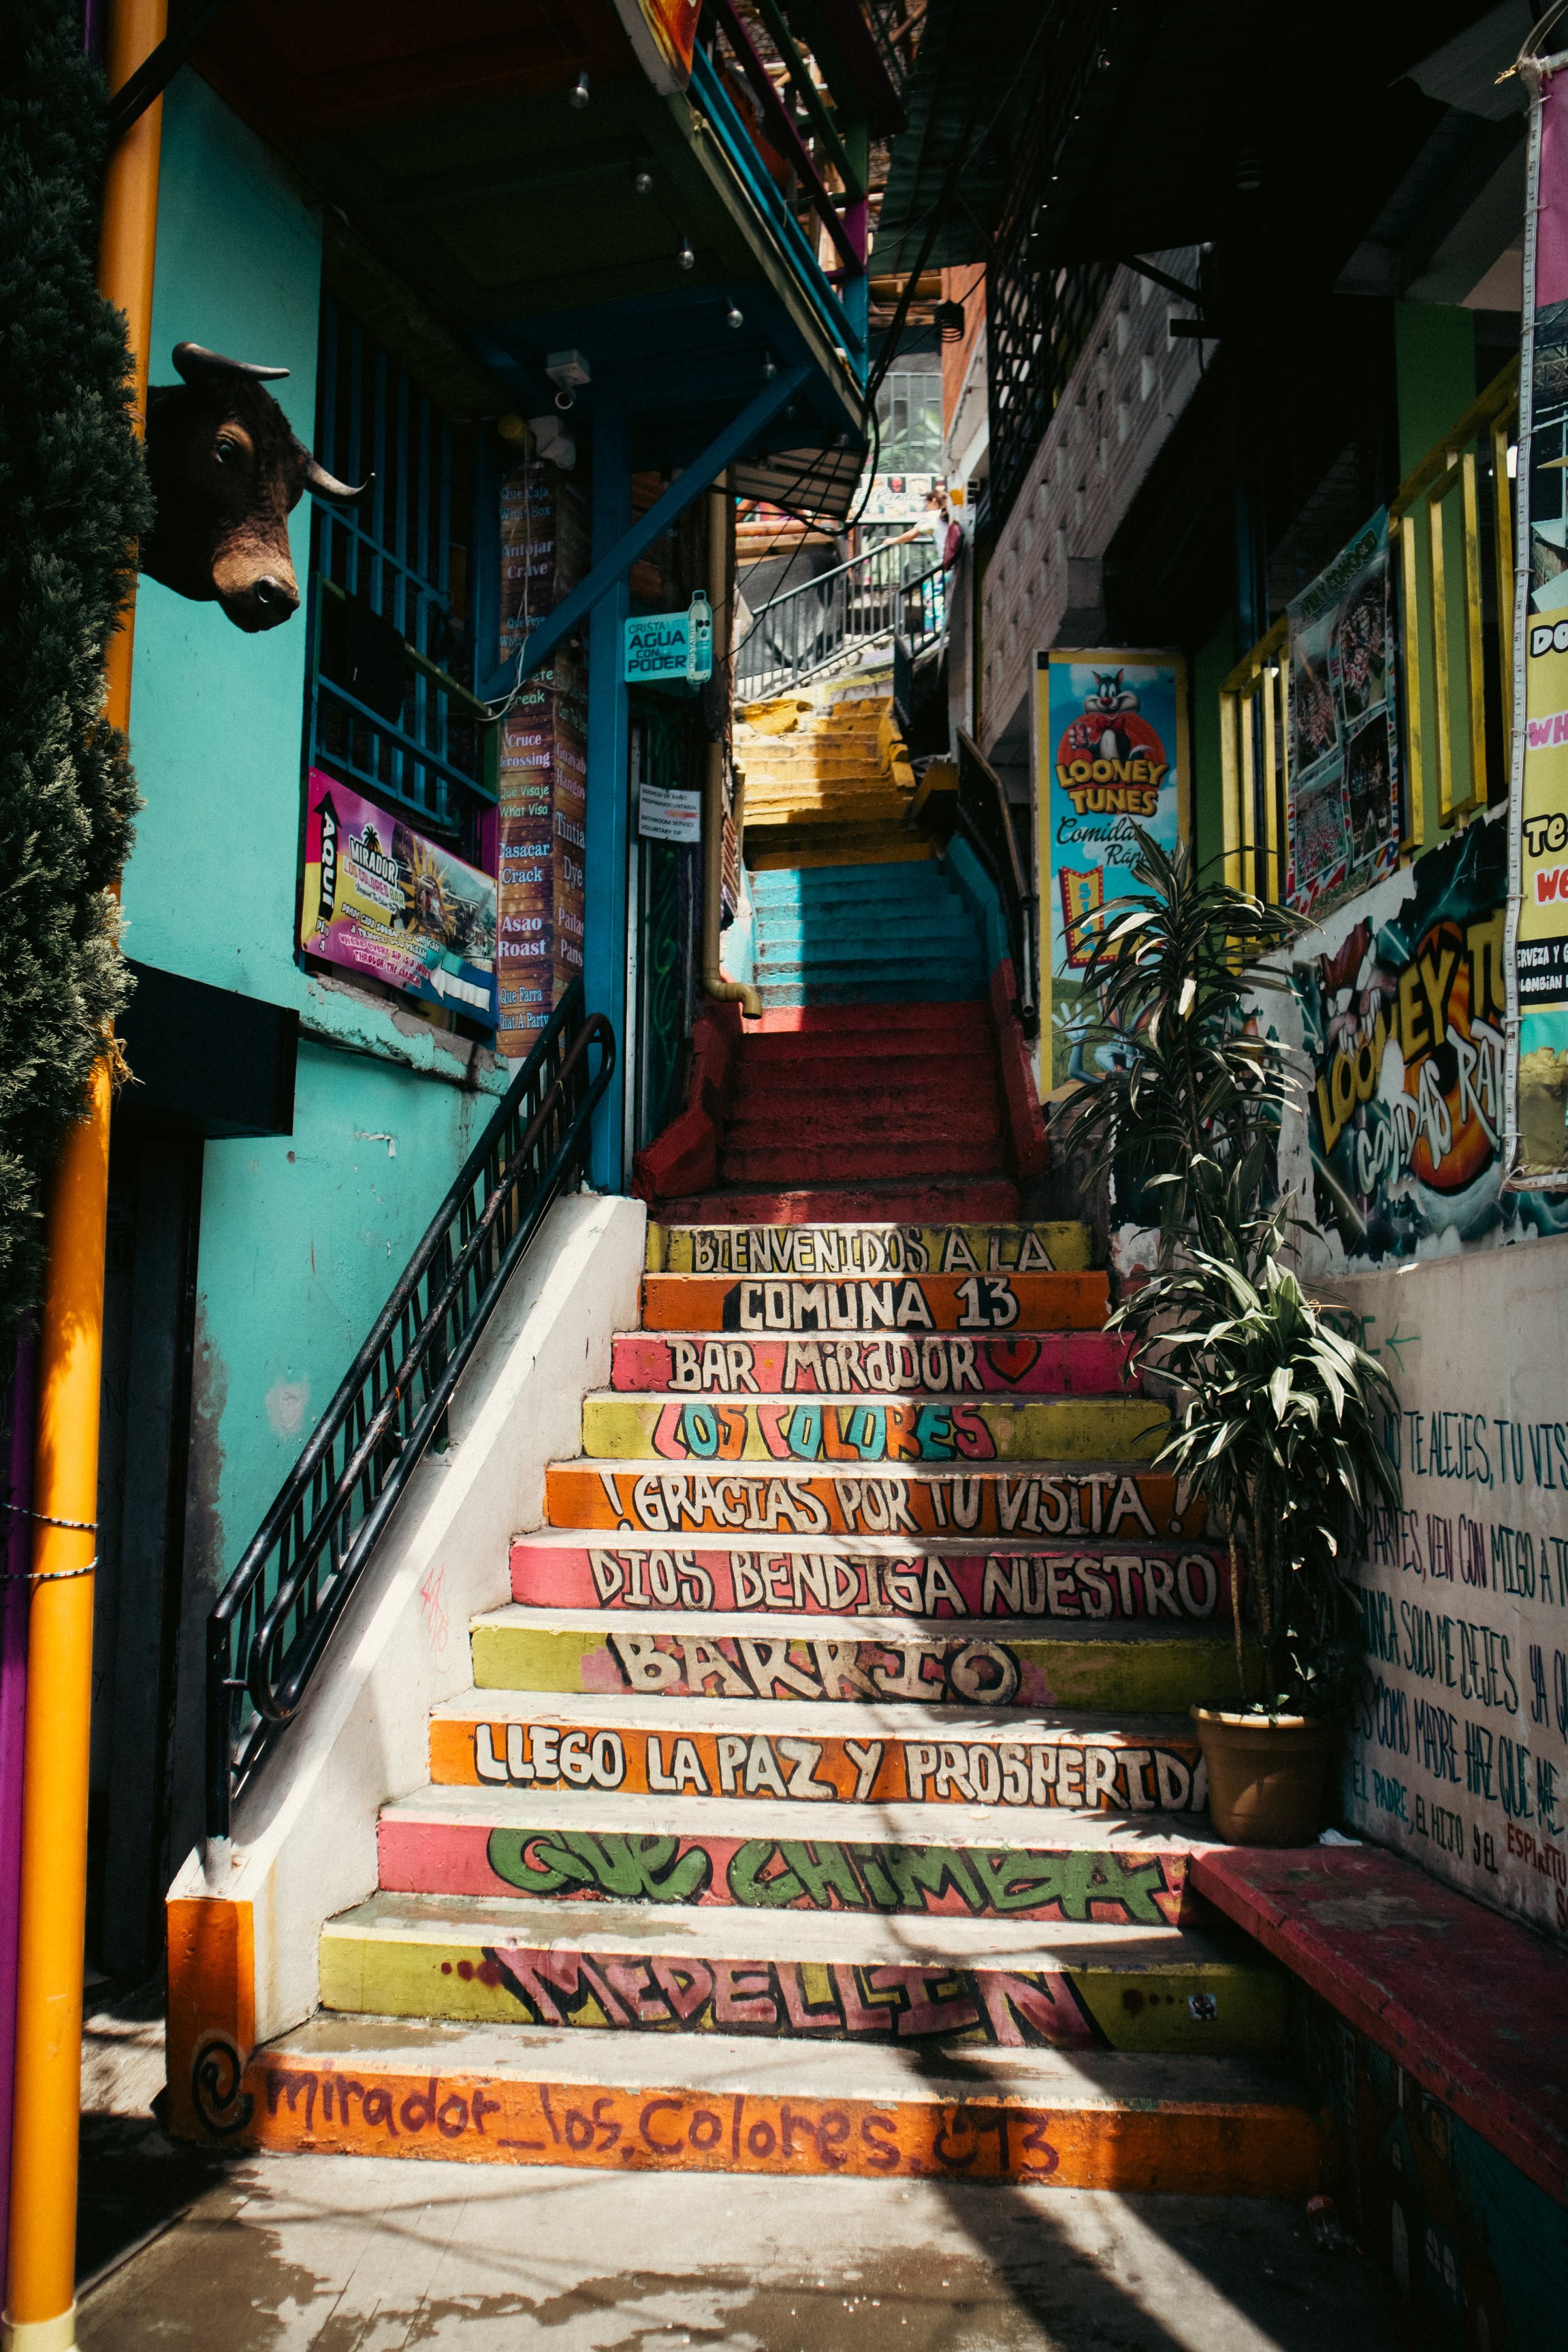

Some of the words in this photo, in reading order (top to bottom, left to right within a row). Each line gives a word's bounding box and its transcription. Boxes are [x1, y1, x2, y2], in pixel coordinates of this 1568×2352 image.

[502, 539, 554, 558] Antojar
[507, 563, 549, 579] Crave
[628, 630, 686, 650] AGUA
[628, 655, 687, 672] PODER
[636, 648, 659, 659] CON
[508, 734, 542, 747] Cruce
[501, 752, 550, 768] Crossing
[1056, 758, 1169, 789] LOONEY
[521, 785, 549, 798] Visaje
[1067, 788, 1159, 817] TUNES
[500, 805, 525, 817] What
[529, 803, 548, 815] Visa
[642, 815, 671, 825] BATHROOM
[641, 824, 671, 834] VOLUNTARY
[1056, 815, 1142, 844] Comida
[350, 837, 397, 887] MIRADOR
[502, 866, 543, 884] Crack
[358, 868, 389, 898] COLORES
[389, 887, 405, 907] BAR
[502, 916, 542, 932] Asao
[499, 939, 546, 957] Roast
[1517, 946, 1549, 968] ERVEZA
[1553, 945, 1560, 963] Y
[500, 988, 516, 1005] Que
[519, 986, 543, 1003] Farra
[518, 1014, 524, 1029] A
[526, 1012, 549, 1030] Party
[693, 1227, 928, 1273] BIENVENIDOS
[943, 1231, 980, 1273] A
[987, 1232, 1056, 1273] LA
[734, 1278, 936, 1331] COMUNA
[956, 1276, 1019, 1329] 13
[666, 1339, 760, 1392] BAR
[652, 1403, 748, 1460] LOS
[758, 1403, 997, 1462] COLORES
[1404, 1411, 1426, 1475] TE
[1494, 1419, 1524, 1485] TU
[1528, 1421, 1568, 1491] VIS
[834, 1477, 922, 1534] POR
[916, 1478, 983, 1531] TU
[588, 1549, 715, 1609] DIOS
[729, 1550, 968, 1617] BENDIGA
[982, 1554, 1220, 1619] NUESTRO
[1540, 1538, 1554, 1604] A
[607, 1633, 1022, 1705] BARRIO
[1376, 1675, 1410, 1756] COMO
[474, 1723, 627, 1792] LLEGO
[647, 1735, 713, 1796] LA
[716, 1734, 838, 1801] PAZ
[844, 1738, 886, 1801] Y
[1352, 1759, 1369, 1802] EL
[1416, 1793, 1429, 1837] EL
[1431, 1803, 1464, 1859] HIJO
[1484, 1831, 1499, 1874] EL
